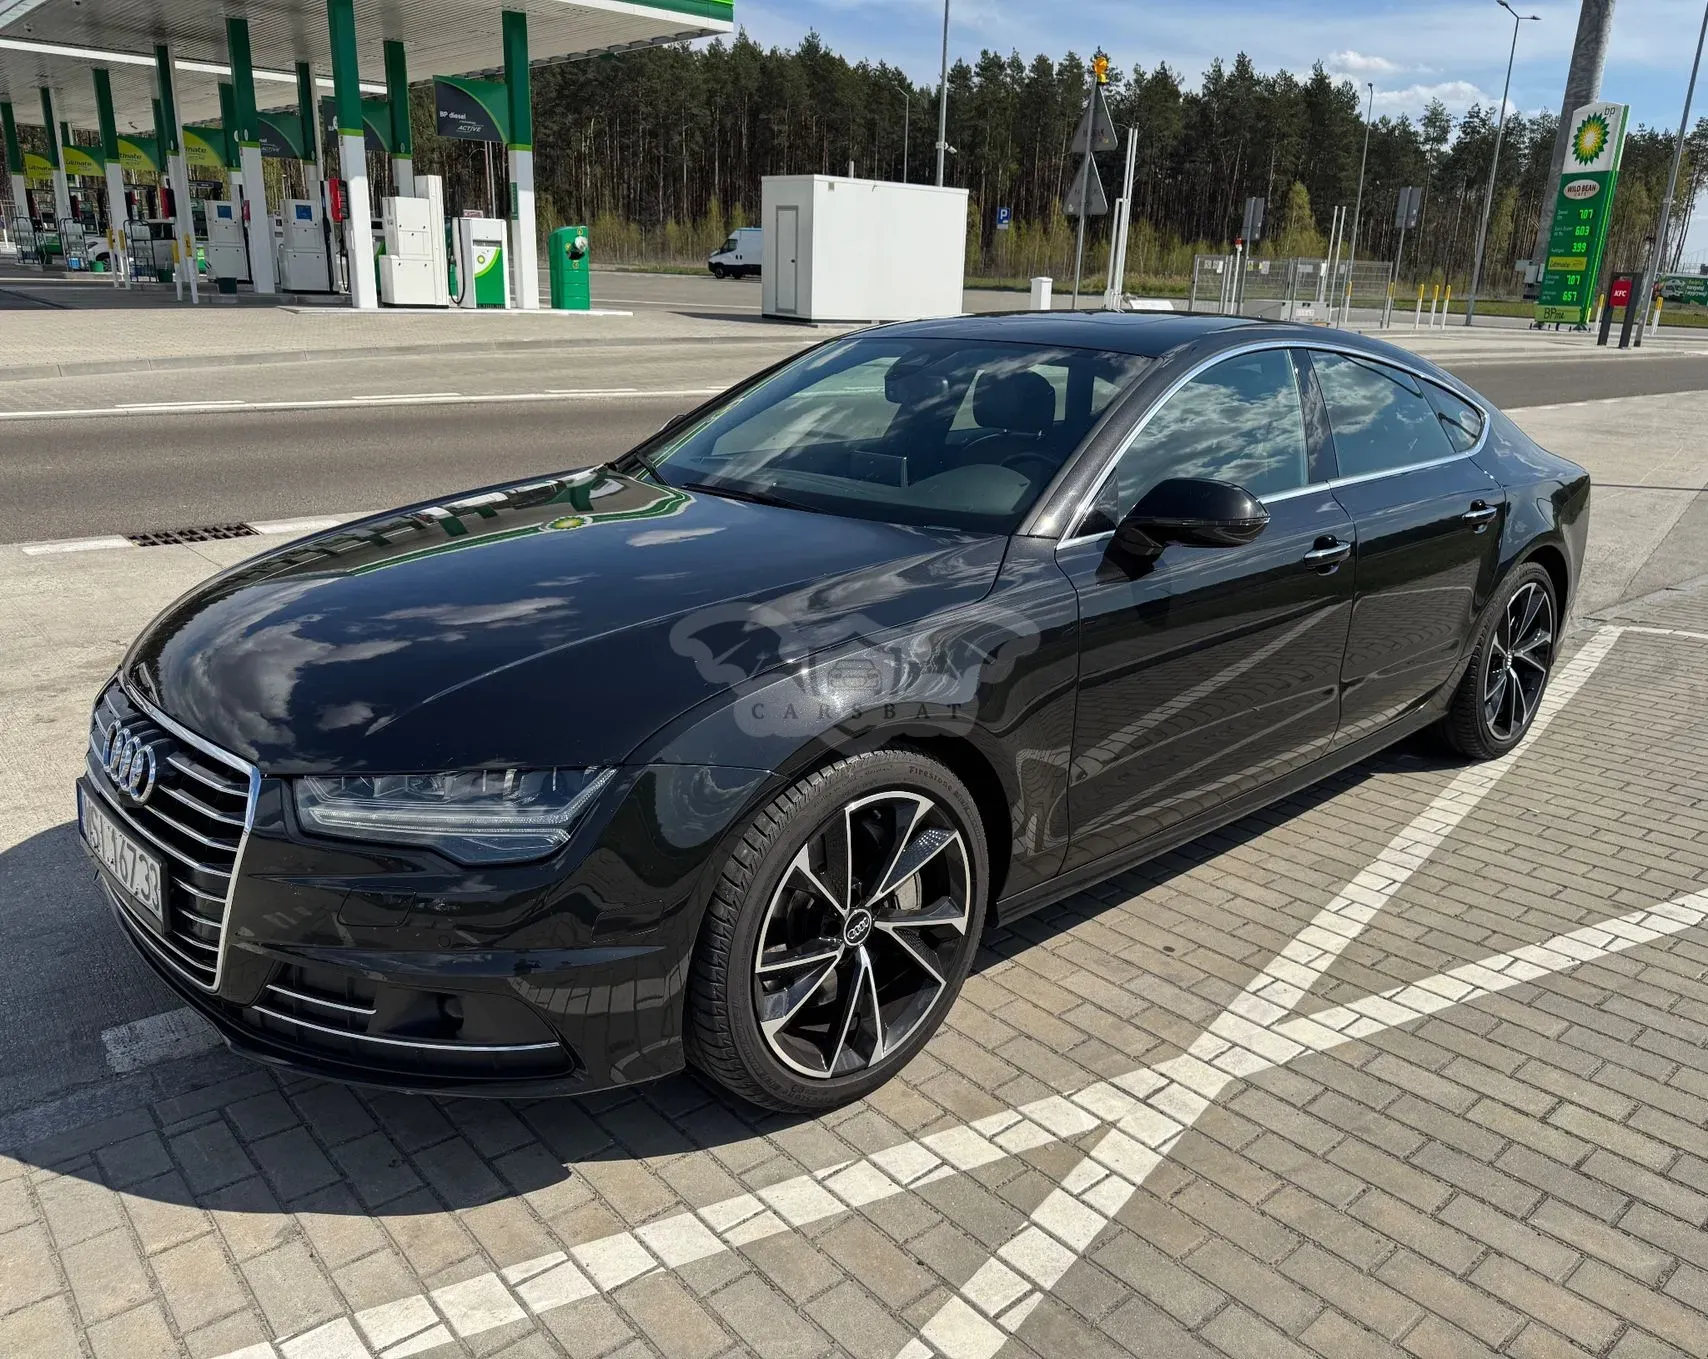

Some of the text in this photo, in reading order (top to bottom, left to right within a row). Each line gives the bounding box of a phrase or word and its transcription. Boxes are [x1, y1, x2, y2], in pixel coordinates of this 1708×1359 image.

[1604, 106, 1616, 117] bp
[1567, 184, 1597, 193] WILD BEAN
